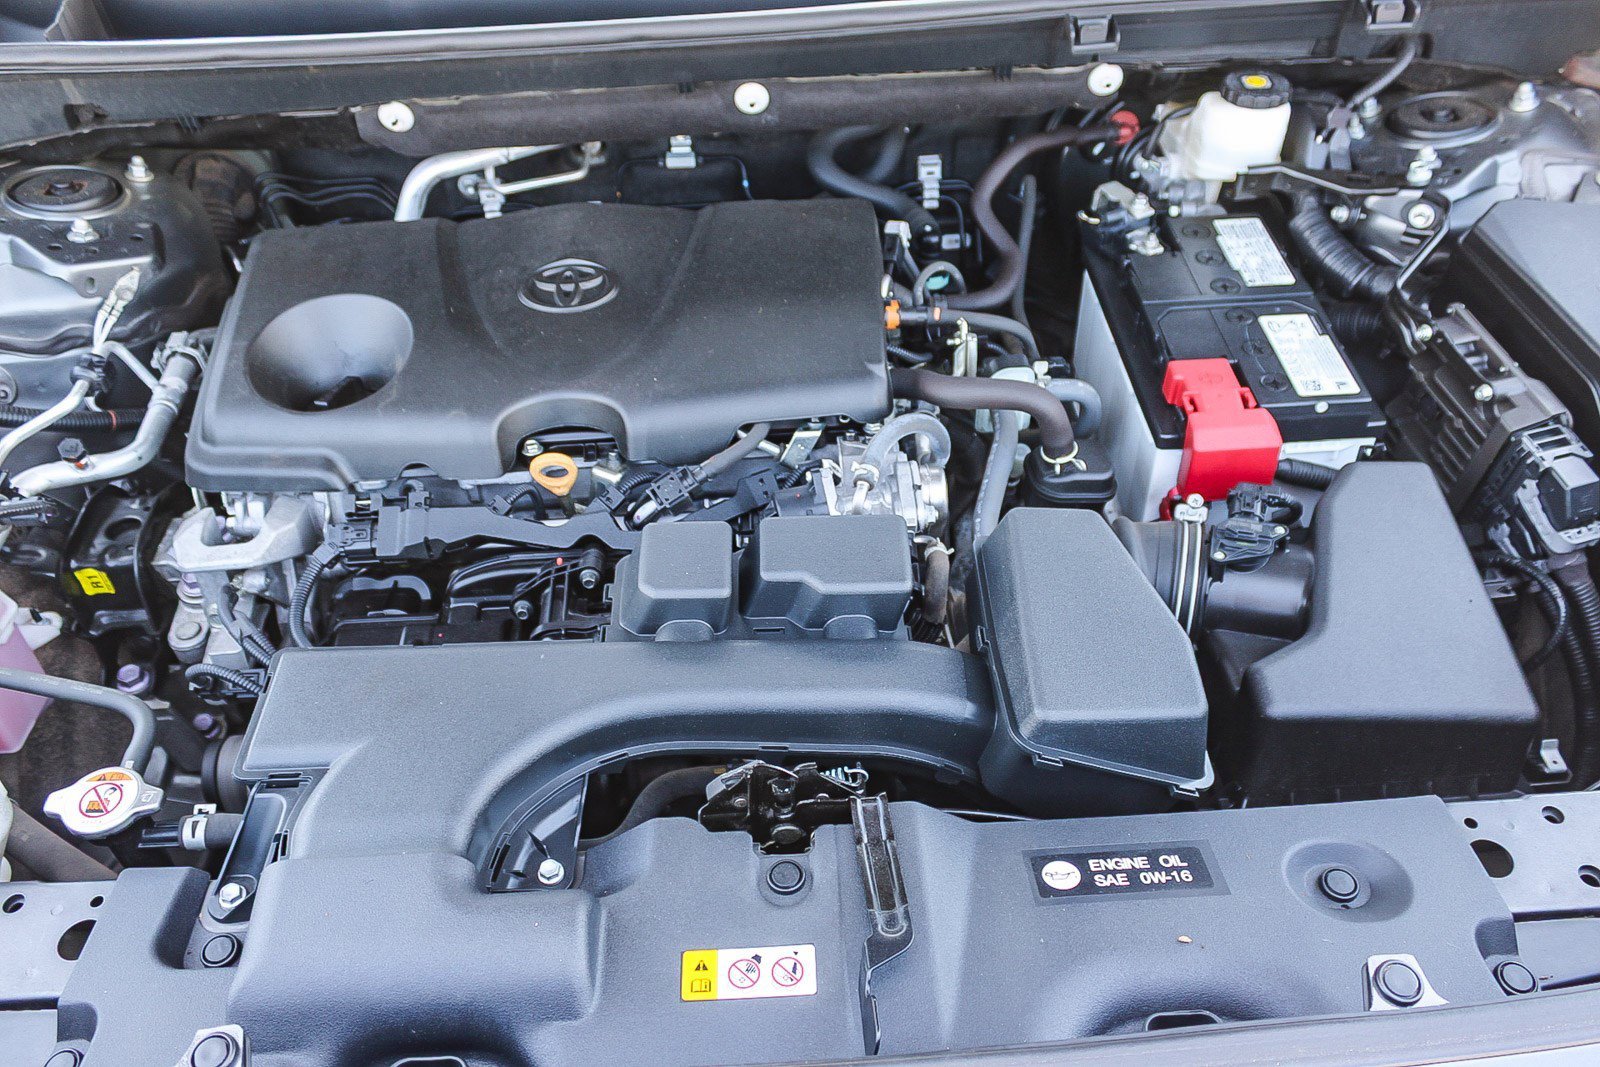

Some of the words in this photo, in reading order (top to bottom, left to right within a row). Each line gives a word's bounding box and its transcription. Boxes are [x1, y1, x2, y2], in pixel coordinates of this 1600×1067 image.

[1088, 856, 1150, 871] ENGINE
[1158, 855, 1188, 867] OIL
[1093, 873, 1130, 887] SAE
[1140, 870, 1193, 884] 0W-16
